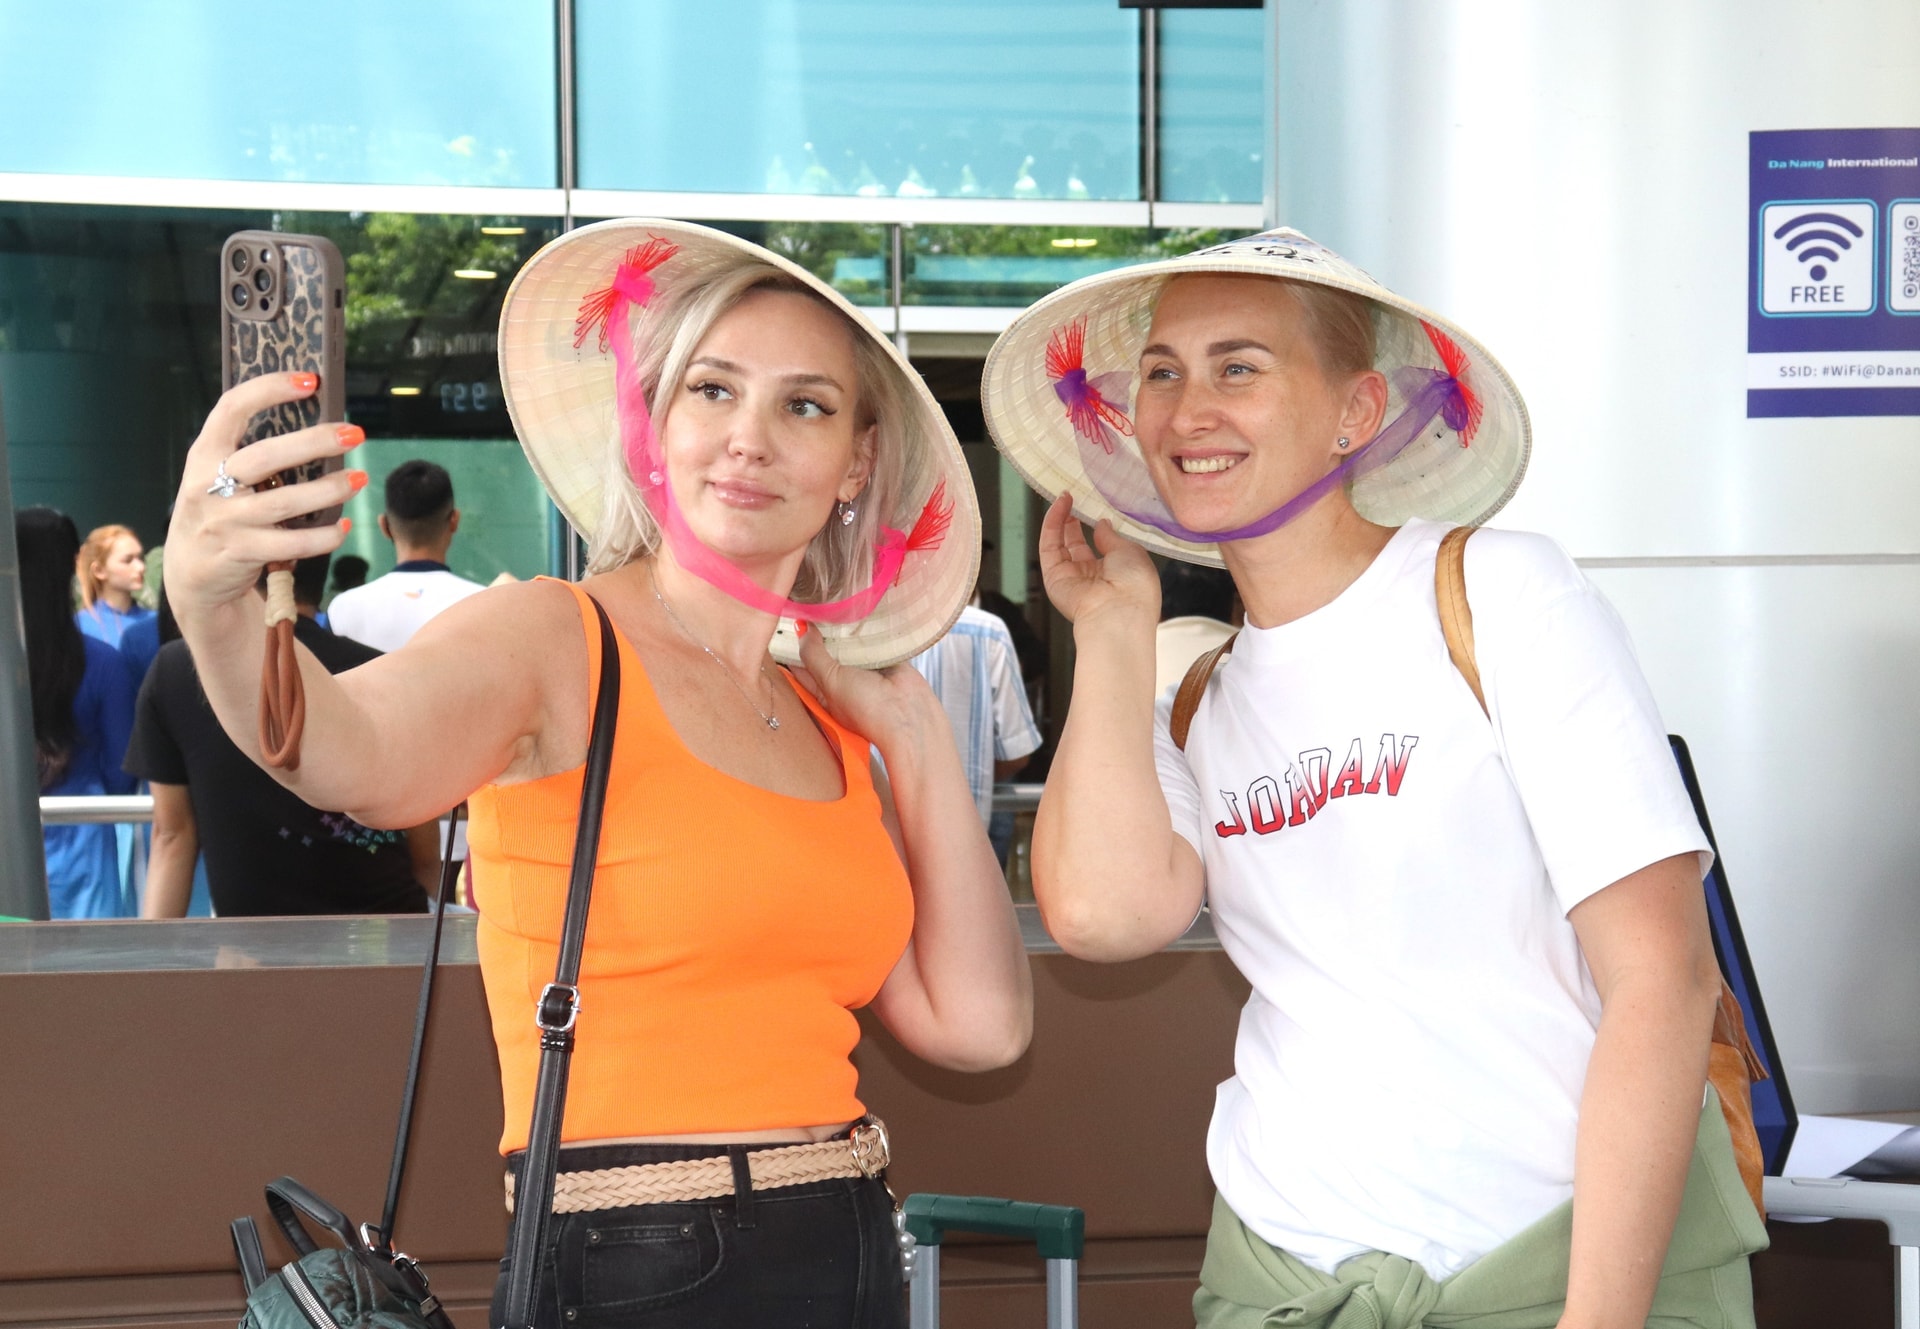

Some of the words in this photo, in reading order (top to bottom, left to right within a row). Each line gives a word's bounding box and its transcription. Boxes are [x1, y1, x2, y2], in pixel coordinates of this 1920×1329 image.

[1768, 160, 1787, 169] Da
[1789, 159, 1824, 170] Nang
[1827, 157, 1918, 168] International
[1791, 285, 1845, 303] FREE
[1779, 365, 1817, 377] SSID:
